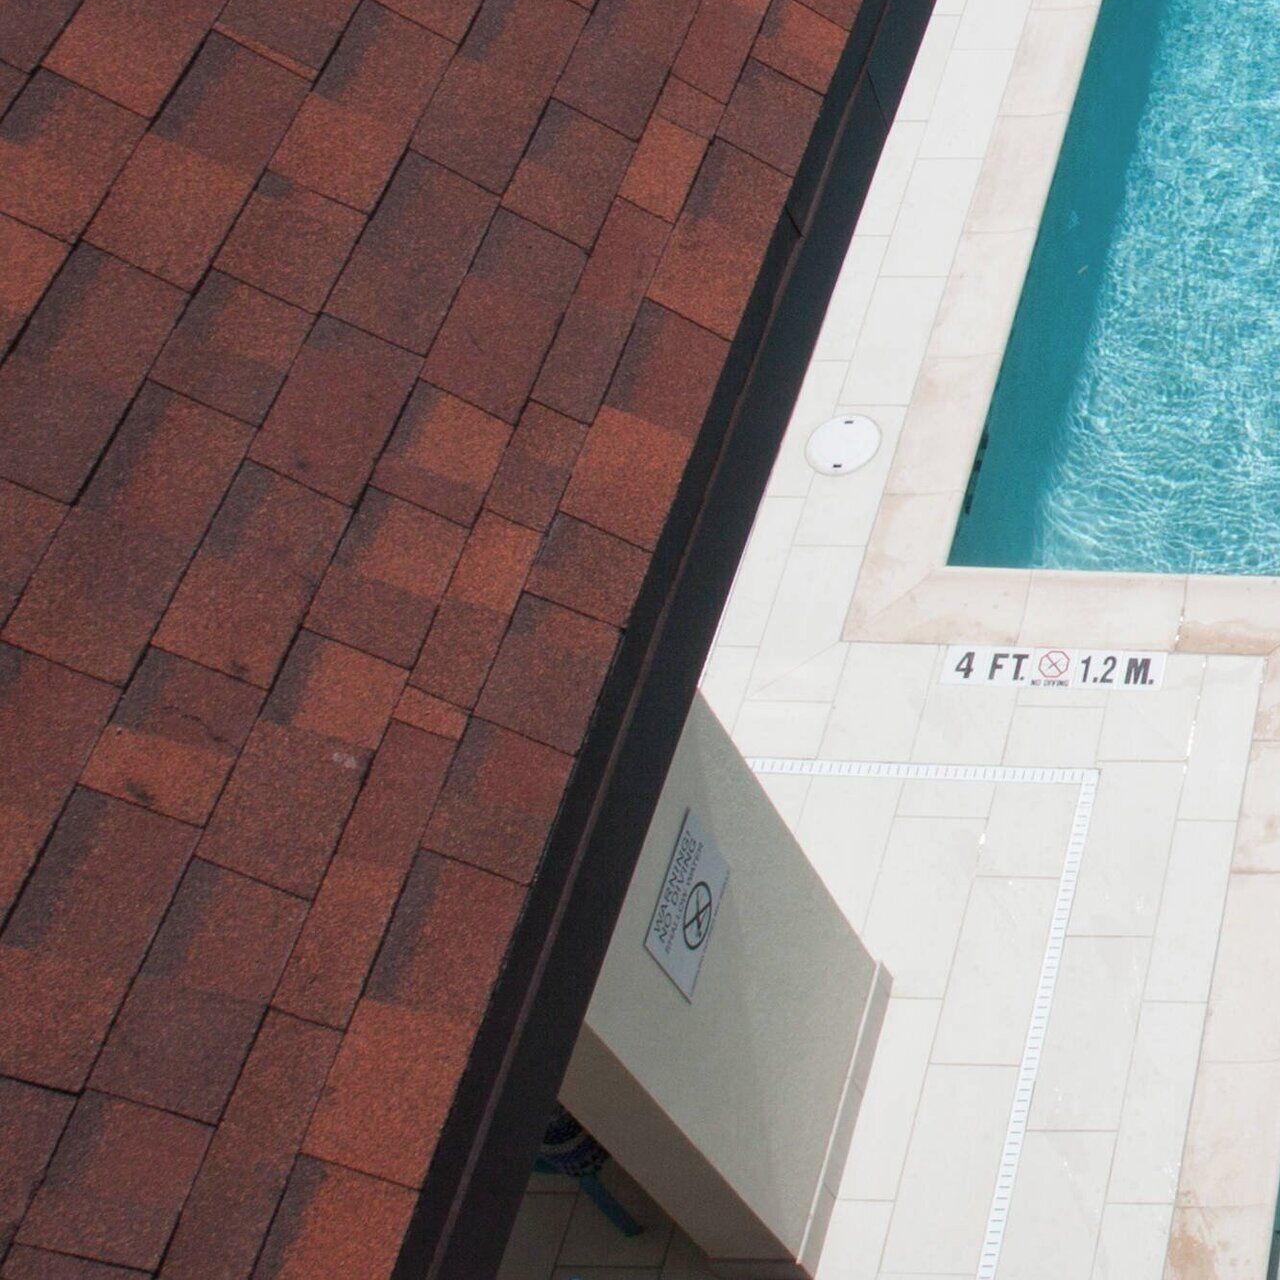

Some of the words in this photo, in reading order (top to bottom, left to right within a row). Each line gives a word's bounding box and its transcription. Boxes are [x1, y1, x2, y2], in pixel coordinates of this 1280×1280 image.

[954, 651, 976, 679] 4
[988, 653, 1029, 681] FT.
[1081, 656, 1117, 684] 1.2
[1123, 657, 1155, 686] M.
[658, 911, 673, 944] NO
[670, 837, 698, 907] DIVING
